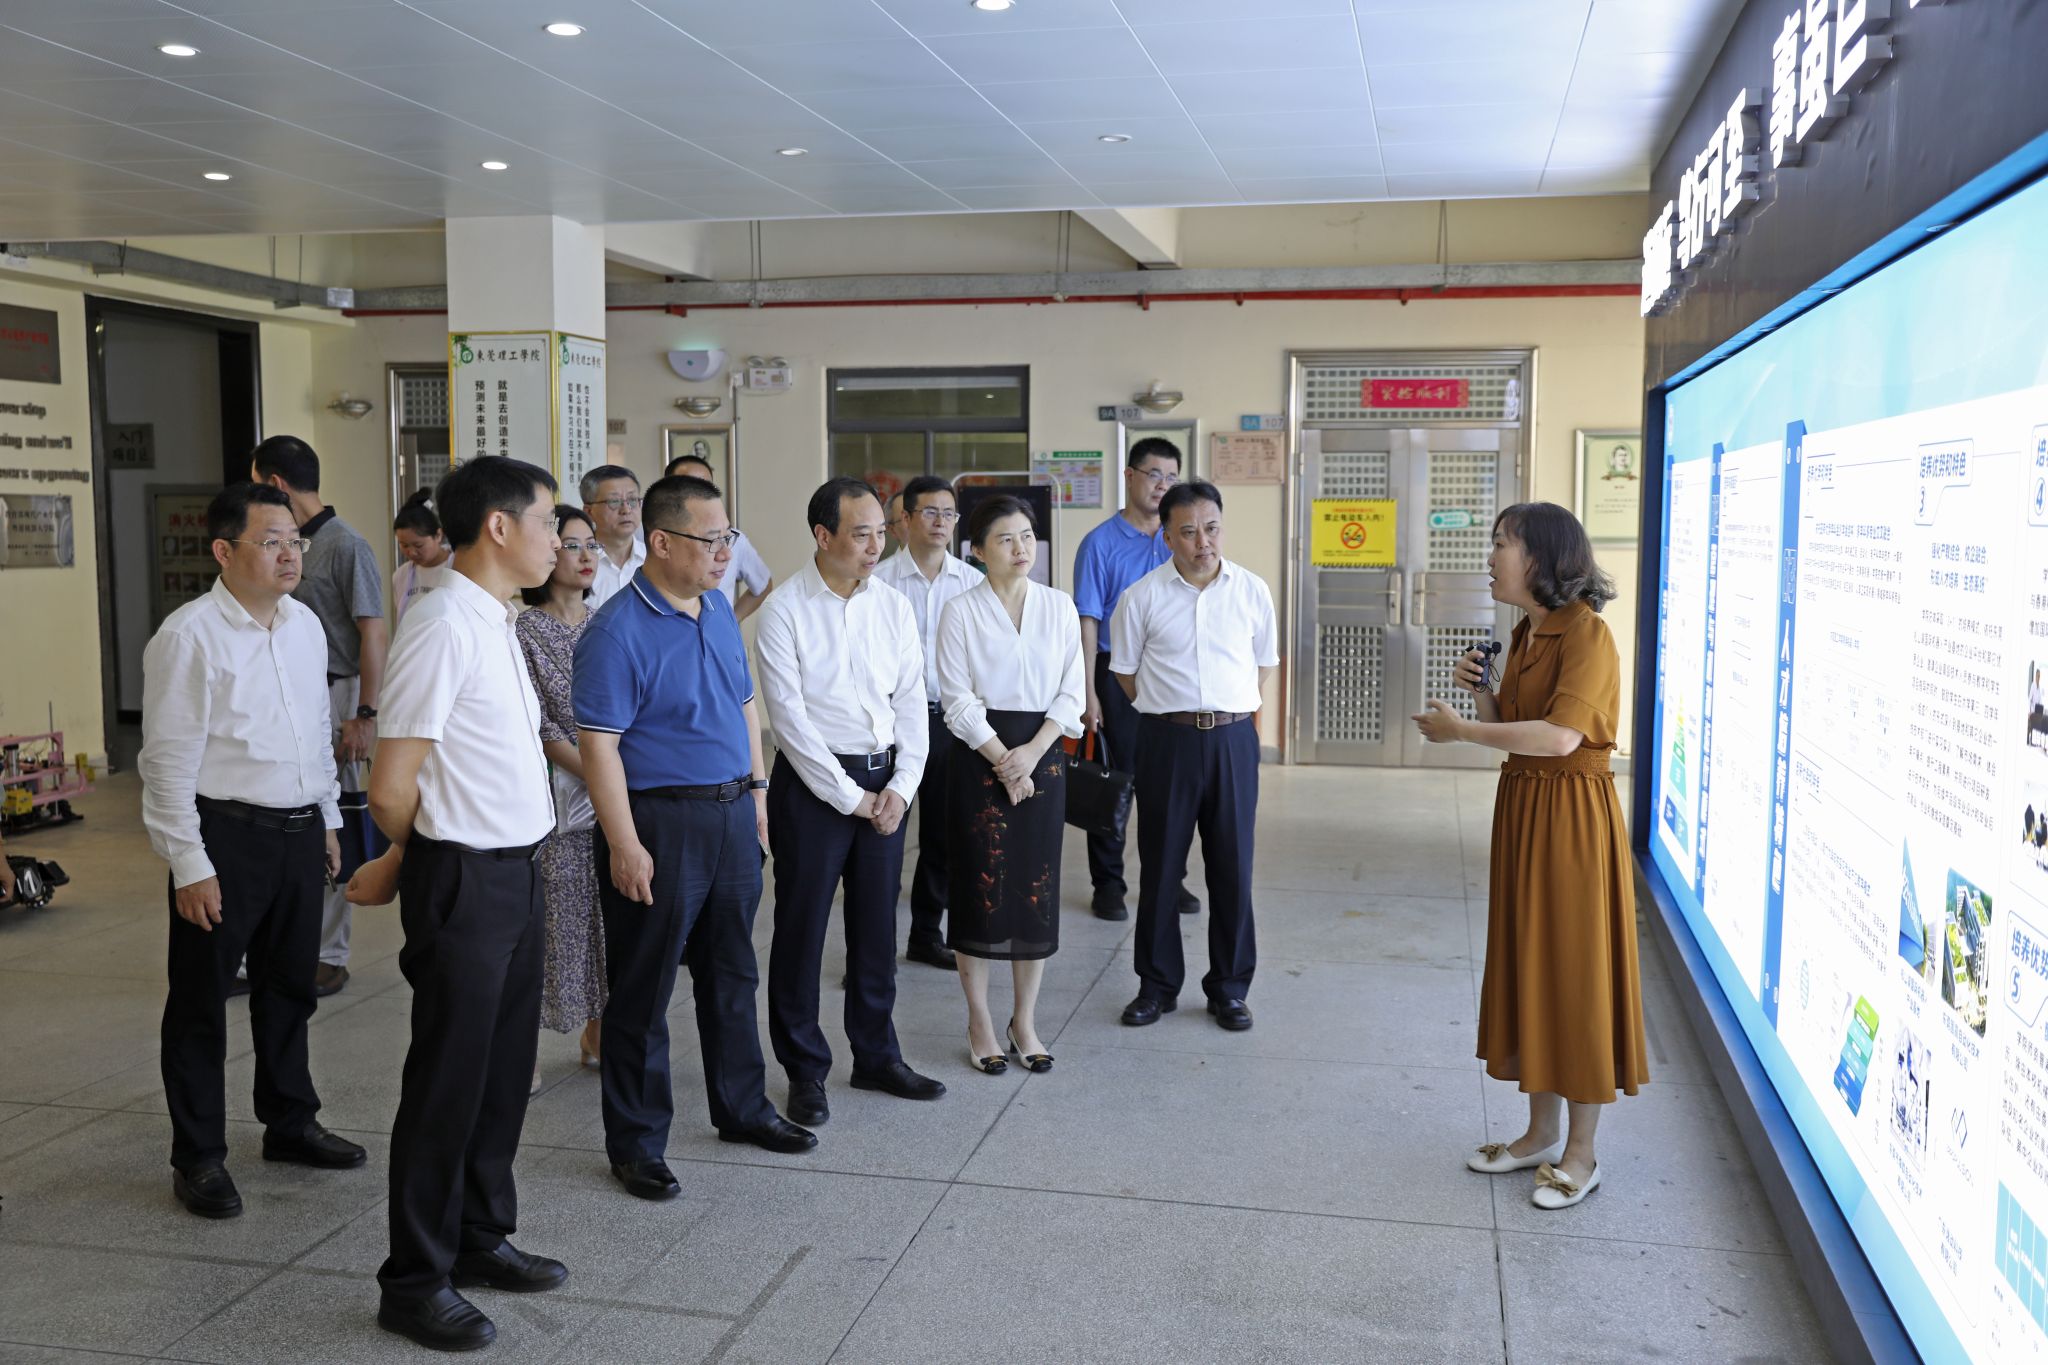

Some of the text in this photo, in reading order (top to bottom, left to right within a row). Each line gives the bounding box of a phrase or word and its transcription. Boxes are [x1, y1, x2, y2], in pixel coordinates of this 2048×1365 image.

[1121, 408, 1139, 418] 107
[1265, 418, 1284, 428] 107
[1920, 451, 1966, 478] 培养优势和特色
[2036, 483, 2044, 510] 4
[2011, 971, 2020, 998] 5
